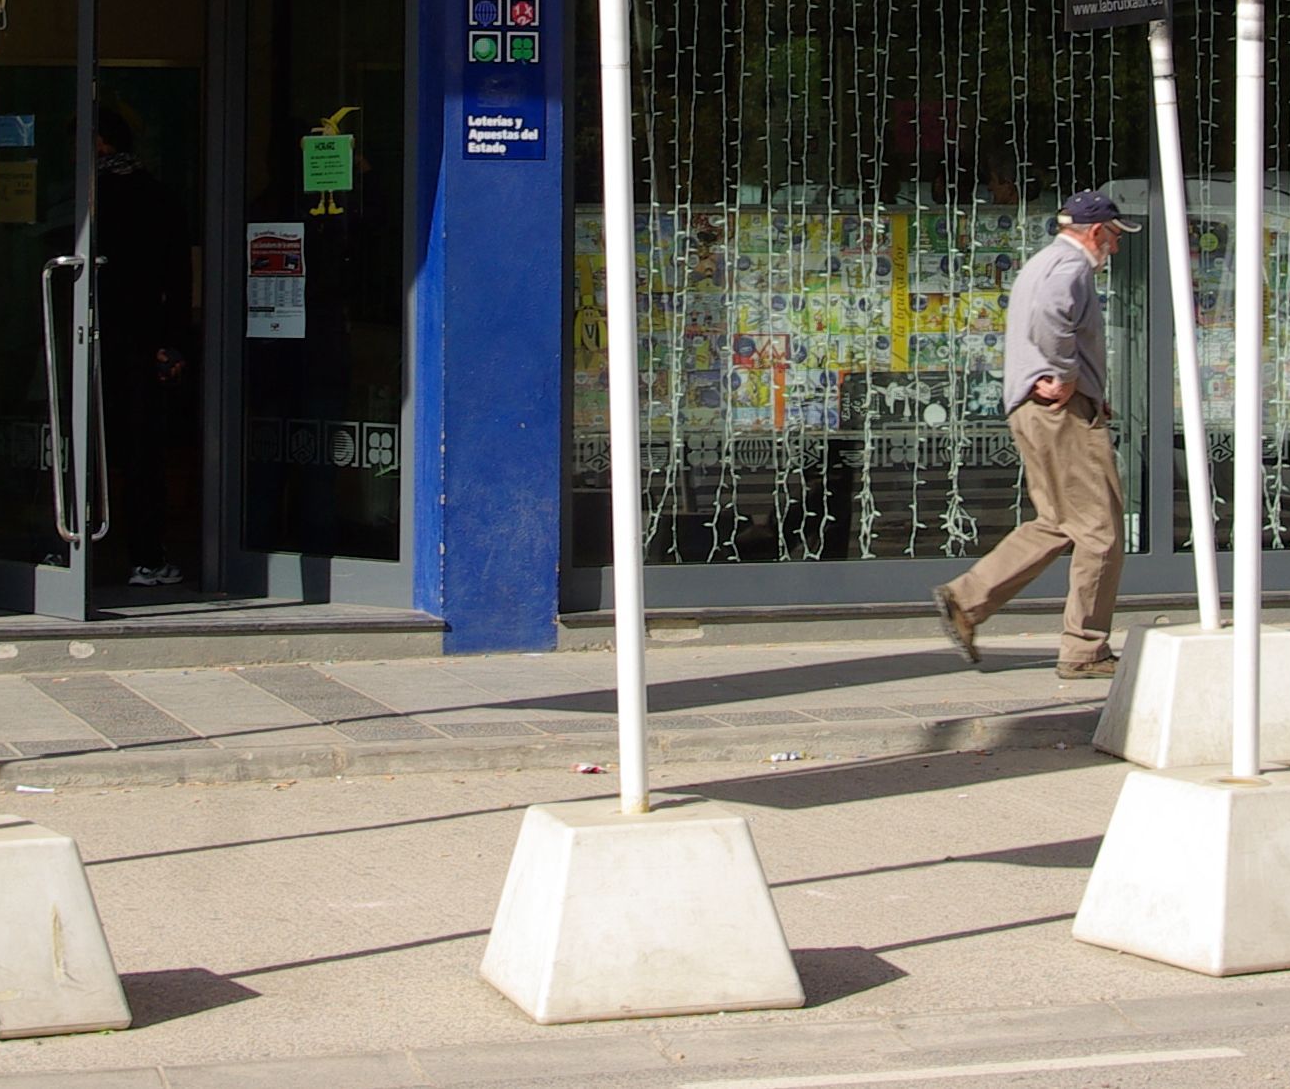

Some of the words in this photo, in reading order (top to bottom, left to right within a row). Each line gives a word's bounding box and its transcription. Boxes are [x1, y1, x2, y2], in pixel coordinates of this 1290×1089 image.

[468, 115, 513, 127] Loterías
[515, 118, 523, 129] y
[468, 129, 519, 142] Apuestas
[521, 128, 538, 140] del
[468, 142, 506, 153] Estado
